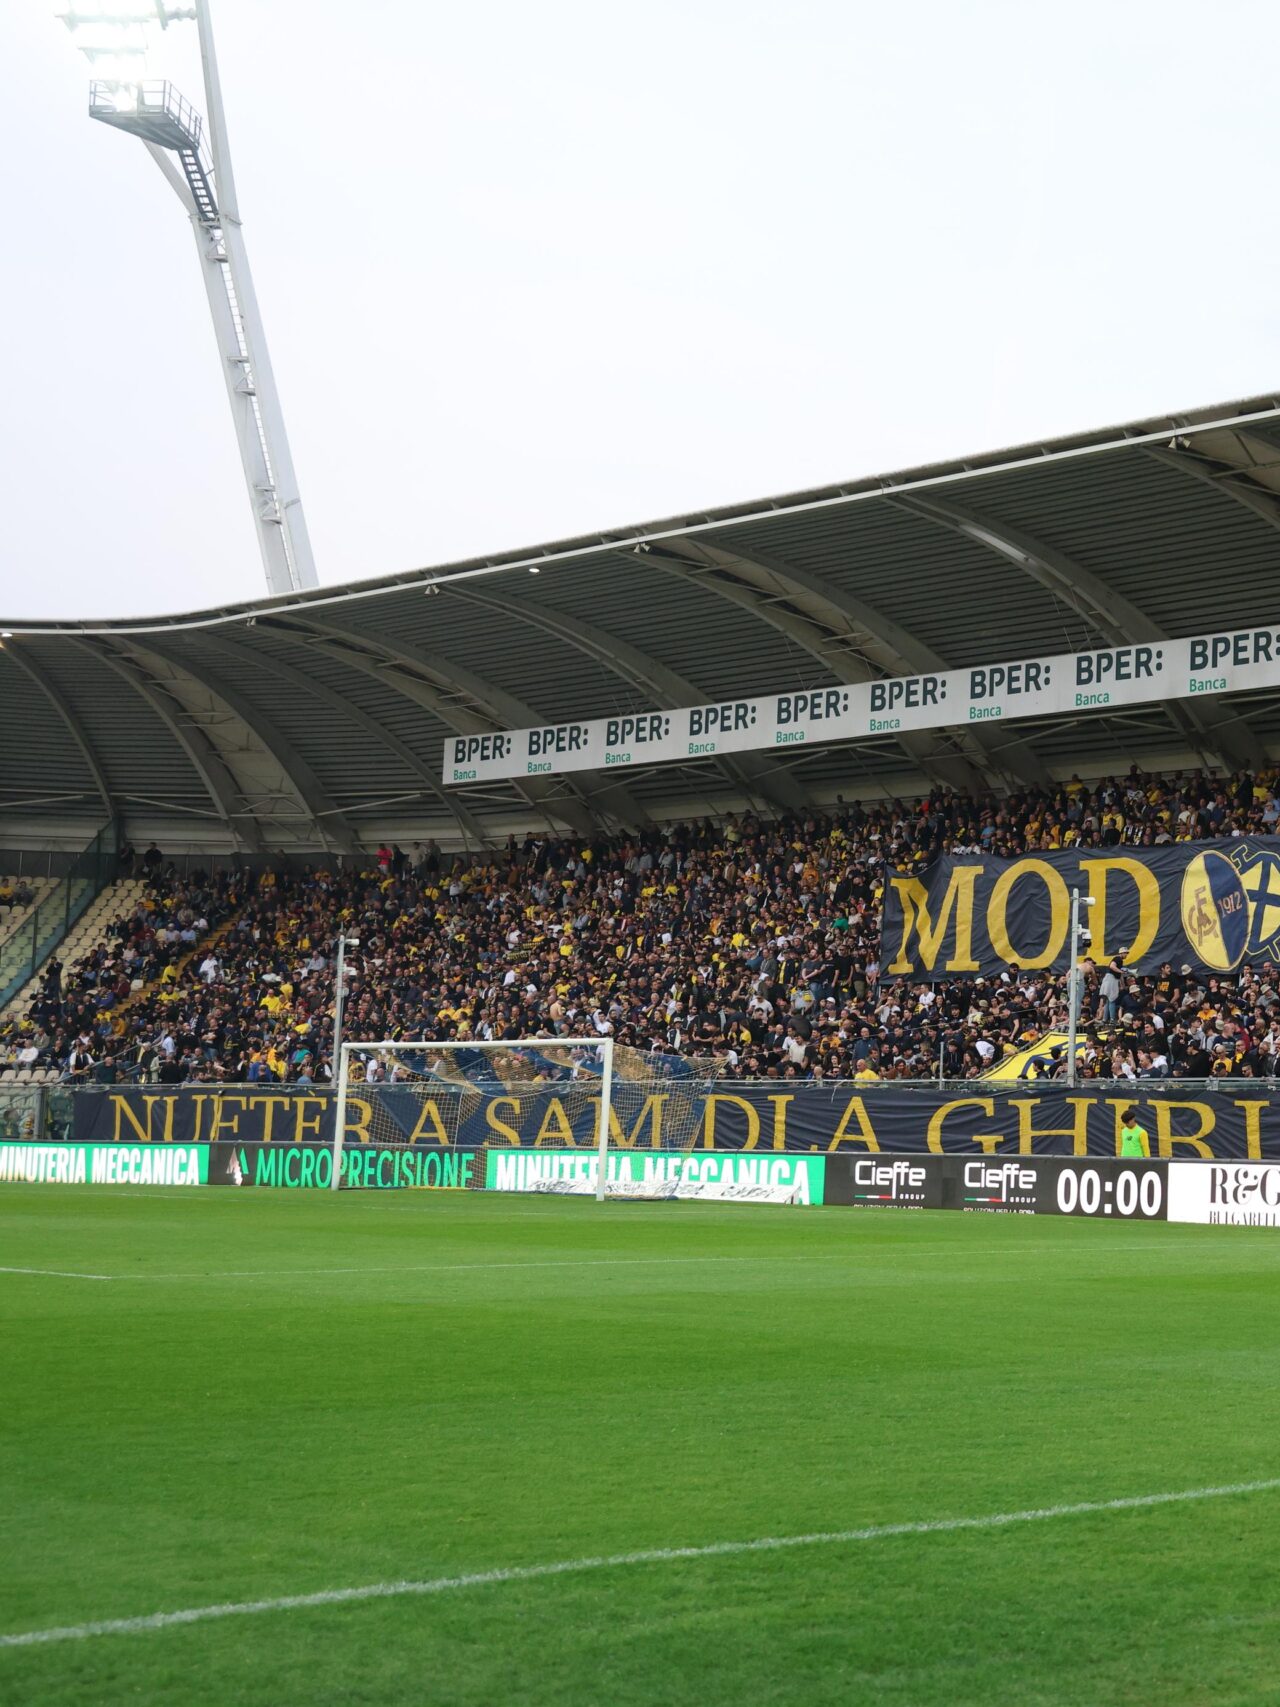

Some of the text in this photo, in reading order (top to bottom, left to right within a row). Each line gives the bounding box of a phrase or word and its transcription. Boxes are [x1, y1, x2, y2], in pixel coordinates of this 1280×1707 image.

[1190, 677, 1227, 692] Banca
[1076, 692, 1110, 706] Banca
[970, 705, 1001, 720] Banca
[870, 717, 900, 731] Banca
[777, 730, 805, 743] Banca
[689, 741, 715, 754] Banca
[606, 752, 631, 764] Banca
[454, 769, 476, 780] Banca
[528, 761, 552, 773] Banca
[1217, 891, 1243, 918] 1912
[409, 1099, 450, 1145] A
[92, 1147, 200, 1186] MECCANICA
[256, 1147, 476, 1189] MICROPRECISIONE
[854, 1160, 926, 1199] Cieffe
[964, 1161, 1037, 1202] Cieffe
[1056, 1168, 1162, 1217] 00:00
